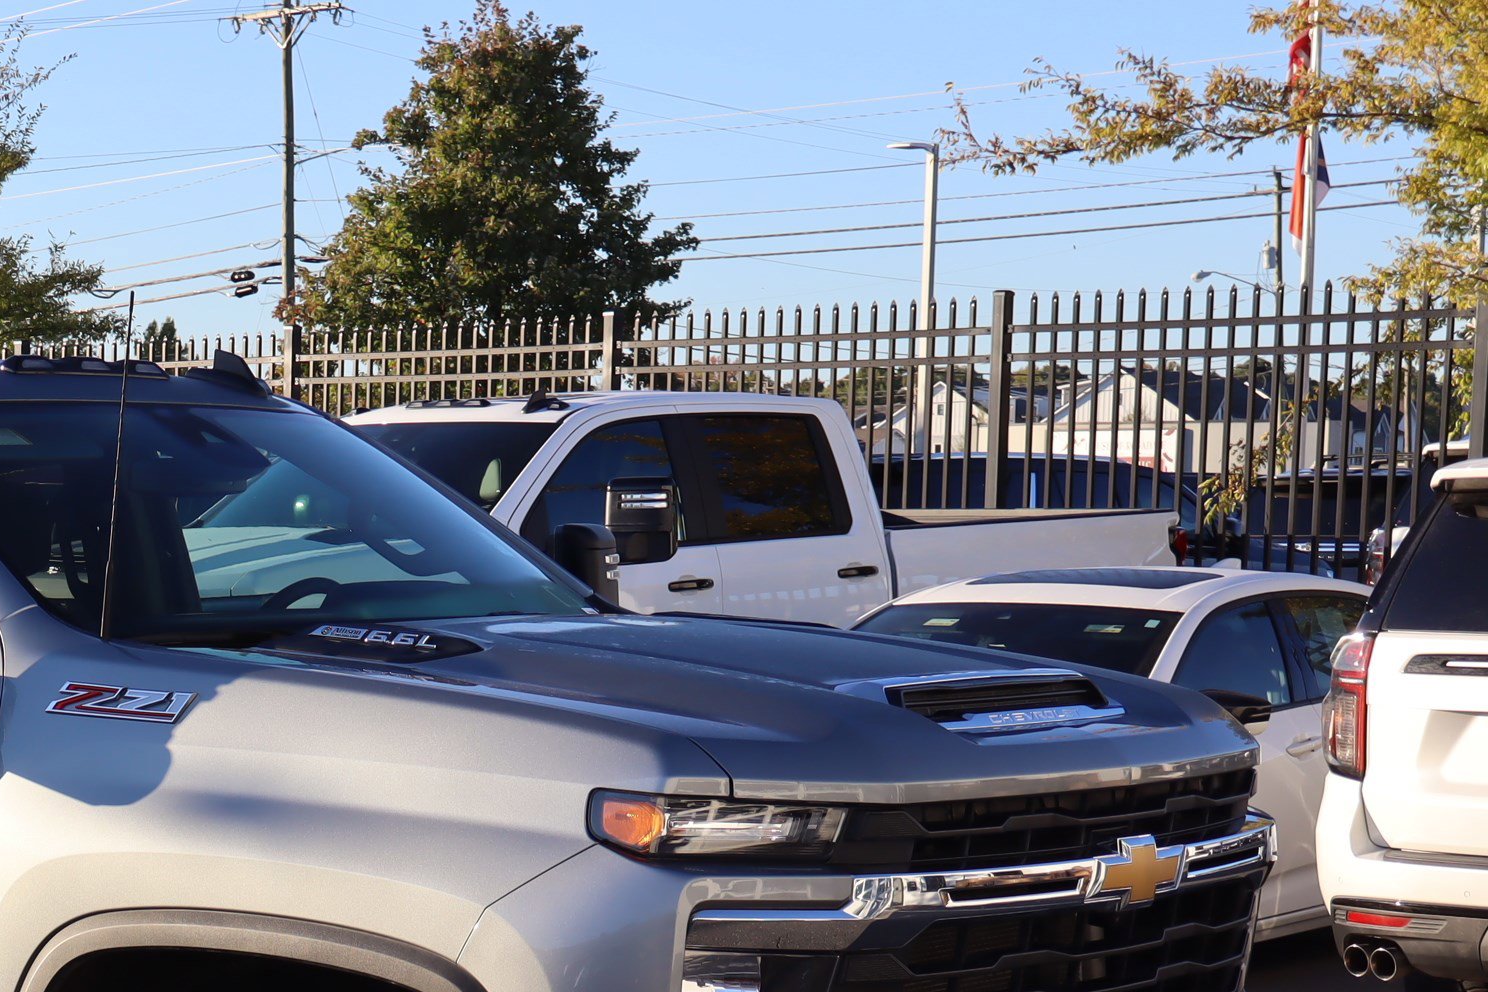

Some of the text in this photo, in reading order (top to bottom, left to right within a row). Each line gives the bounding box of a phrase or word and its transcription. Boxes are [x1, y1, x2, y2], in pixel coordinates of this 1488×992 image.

[332, 626, 437, 649] Allison 6.6L
[45, 680, 199, 724] Z71
[988, 708, 1080, 724] CHEVROLET
